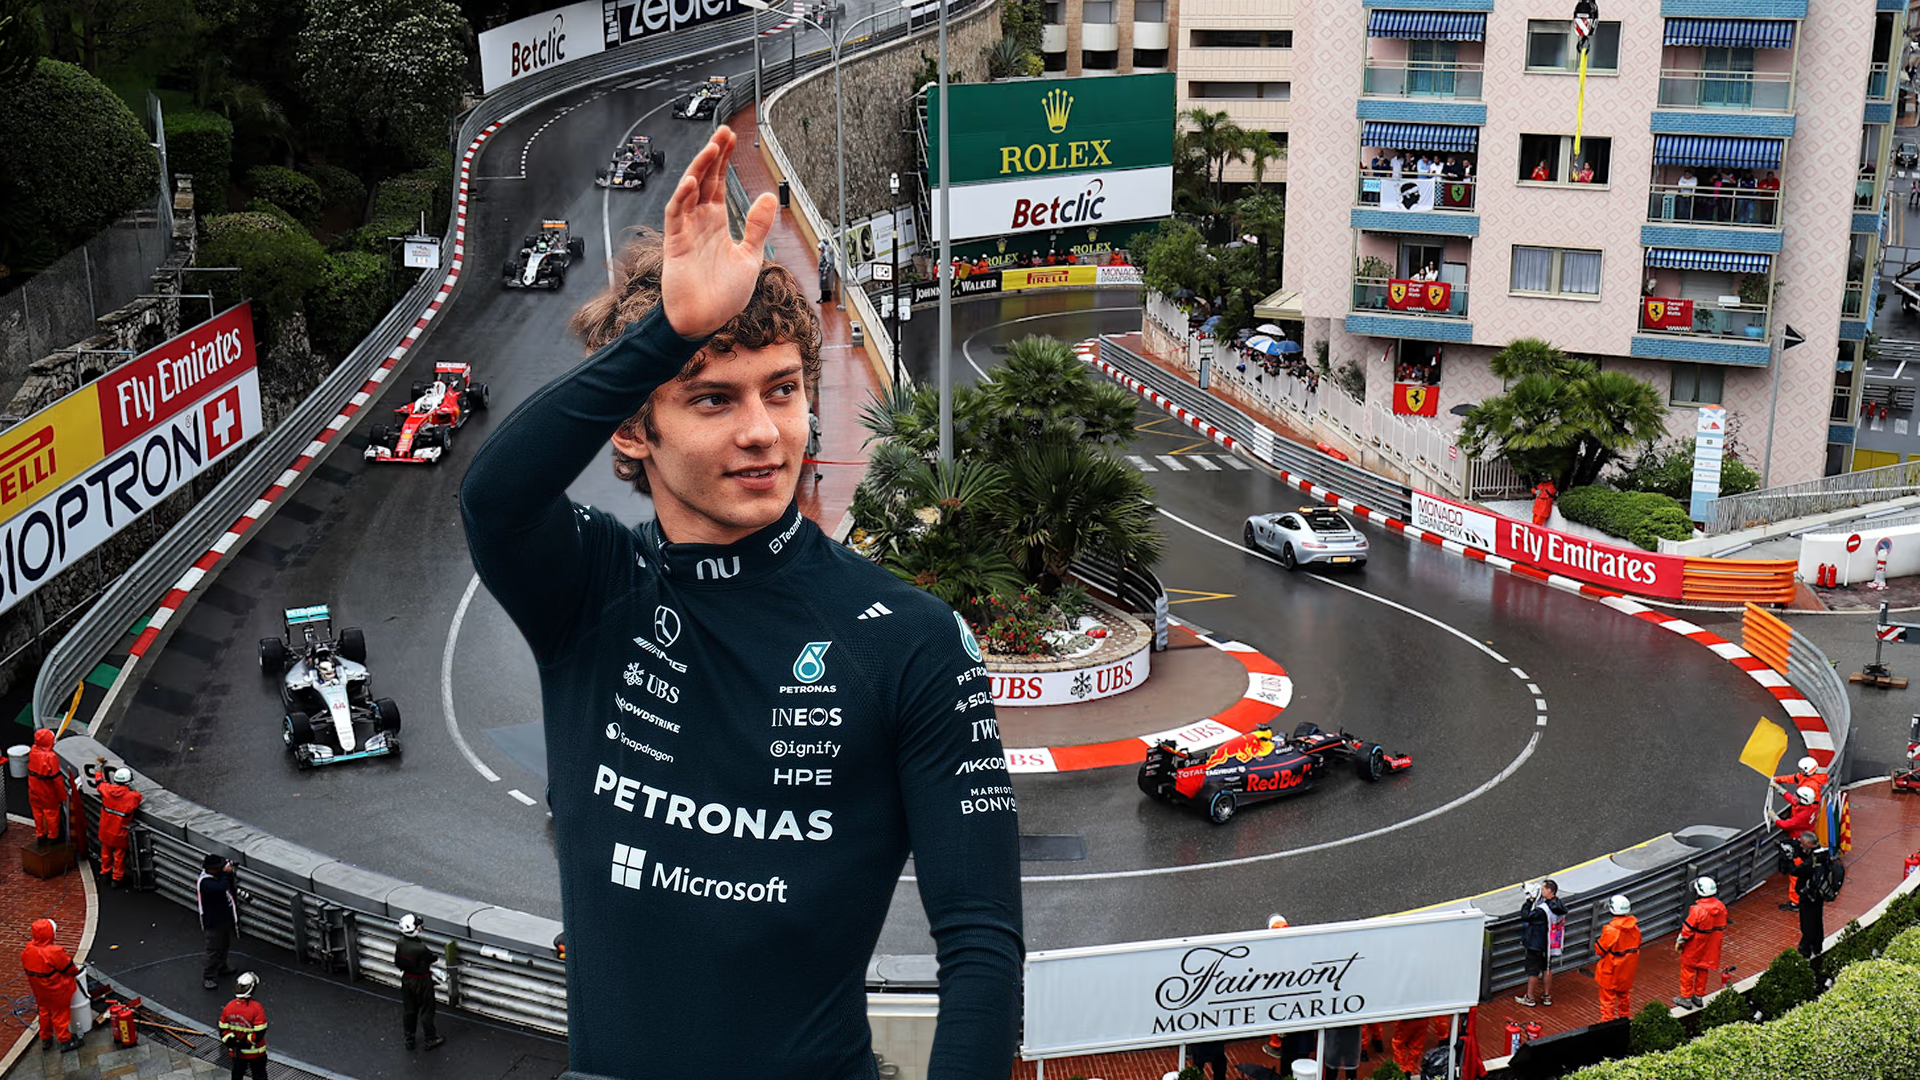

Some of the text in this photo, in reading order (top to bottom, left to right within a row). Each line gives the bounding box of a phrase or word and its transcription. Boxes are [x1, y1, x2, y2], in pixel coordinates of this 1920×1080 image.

[511, 14, 566, 77] Betclic
[1000, 139, 1113, 174] ROLEX
[1011, 178, 1106, 229] Betclic
[1073, 242, 1112, 255] ROLEX
[1027, 270, 1069, 285] PIRELLI
[915, 279, 997, 302] JOHNN WALKER
[117, 327, 242, 429] Fly Emirates
[1418, 498, 1463, 526] MONACO
[1419, 513, 1464, 539] GRANDPRIX
[1511, 522, 1657, 584] Fly Emirates
[651, 648, 688, 673] AMG
[646, 673, 680, 704] UBS
[779, 685, 837, 694] PETRONAS
[989, 676, 1043, 699] UBS
[1097, 661, 1134, 693] UBS
[771, 707, 843, 727] INEOS
[971, 718, 999, 743] IWC
[1178, 722, 1225, 743] UBS
[620, 732, 675, 764] Snapdragon
[1010, 753, 1045, 767] BS
[773, 768, 833, 786] HPE
[955, 757, 1007, 776] AKKOD
[1178, 768, 1204, 779] TOTAL
[594, 764, 834, 841] PETRONAS
[961, 796, 1017, 815] BONVO
[652, 862, 788, 904] Microsoft
[1155, 945, 1365, 1011] Fairmont
[1151, 994, 1365, 1034] MONTE CARLO
